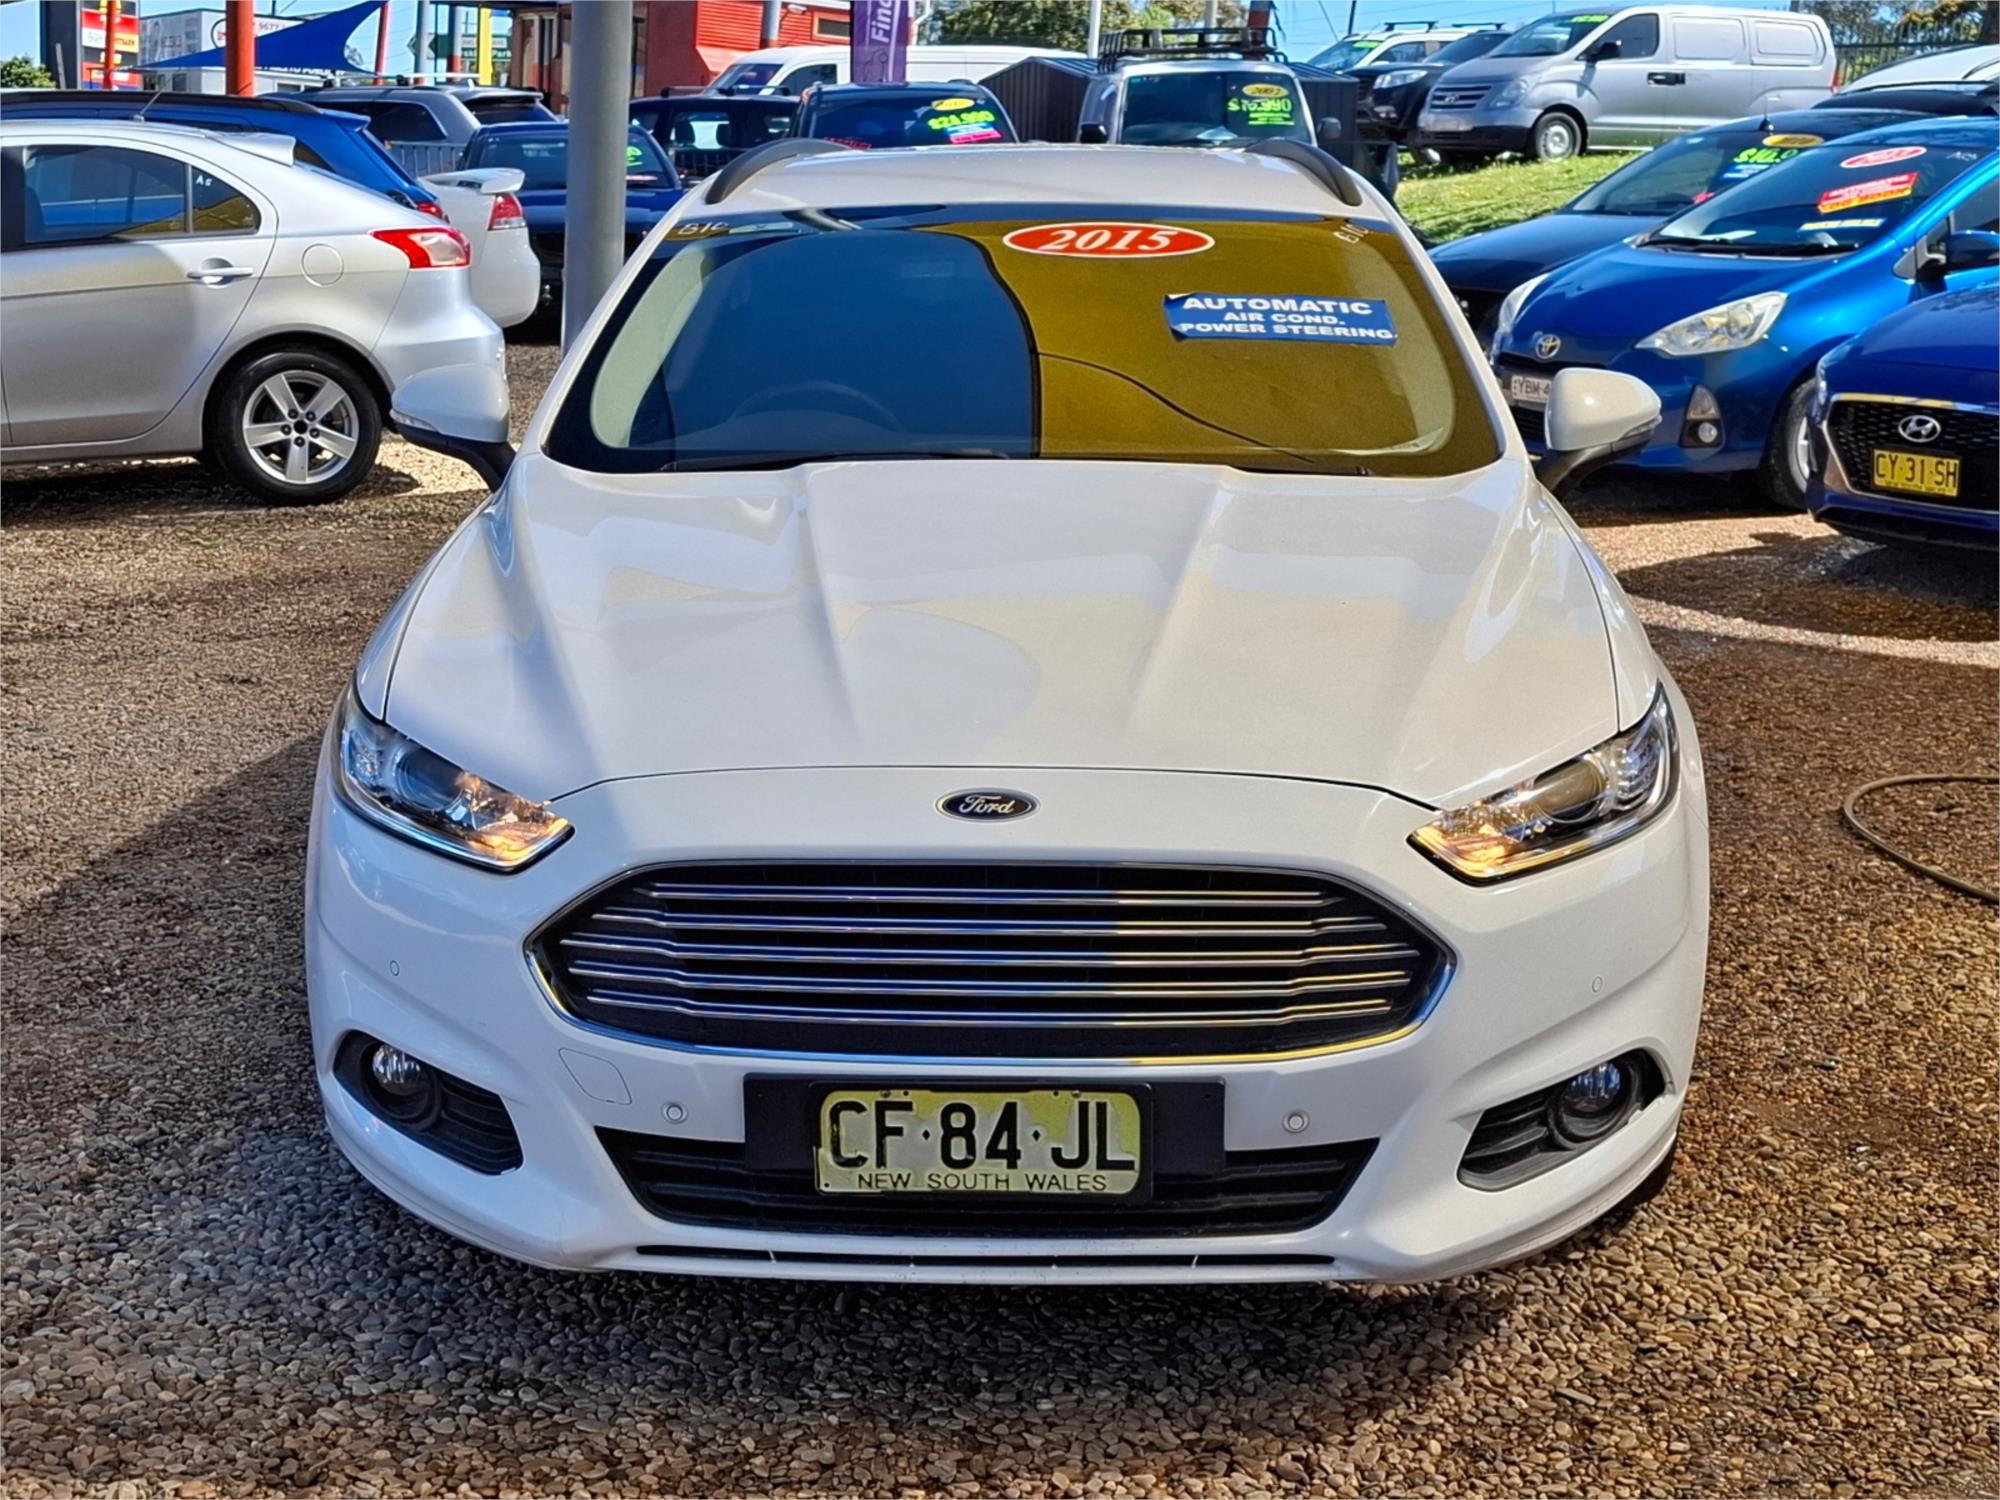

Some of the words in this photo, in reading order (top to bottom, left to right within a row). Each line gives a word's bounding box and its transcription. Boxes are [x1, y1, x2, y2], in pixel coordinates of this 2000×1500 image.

[1037, 229, 1179, 251] 2015
[1183, 297, 1373, 315] AUTOMATIC
[1223, 312, 1265, 322] AIR
[1271, 313, 1345, 325] COND.
[1179, 323, 1267, 334] POWER
[959, 794, 1015, 814] Ford
[857, 1172, 912, 1189] NEW
[927, 1172, 1010, 1190] SOUTH
[1025, 1173, 1107, 1191] WALES
